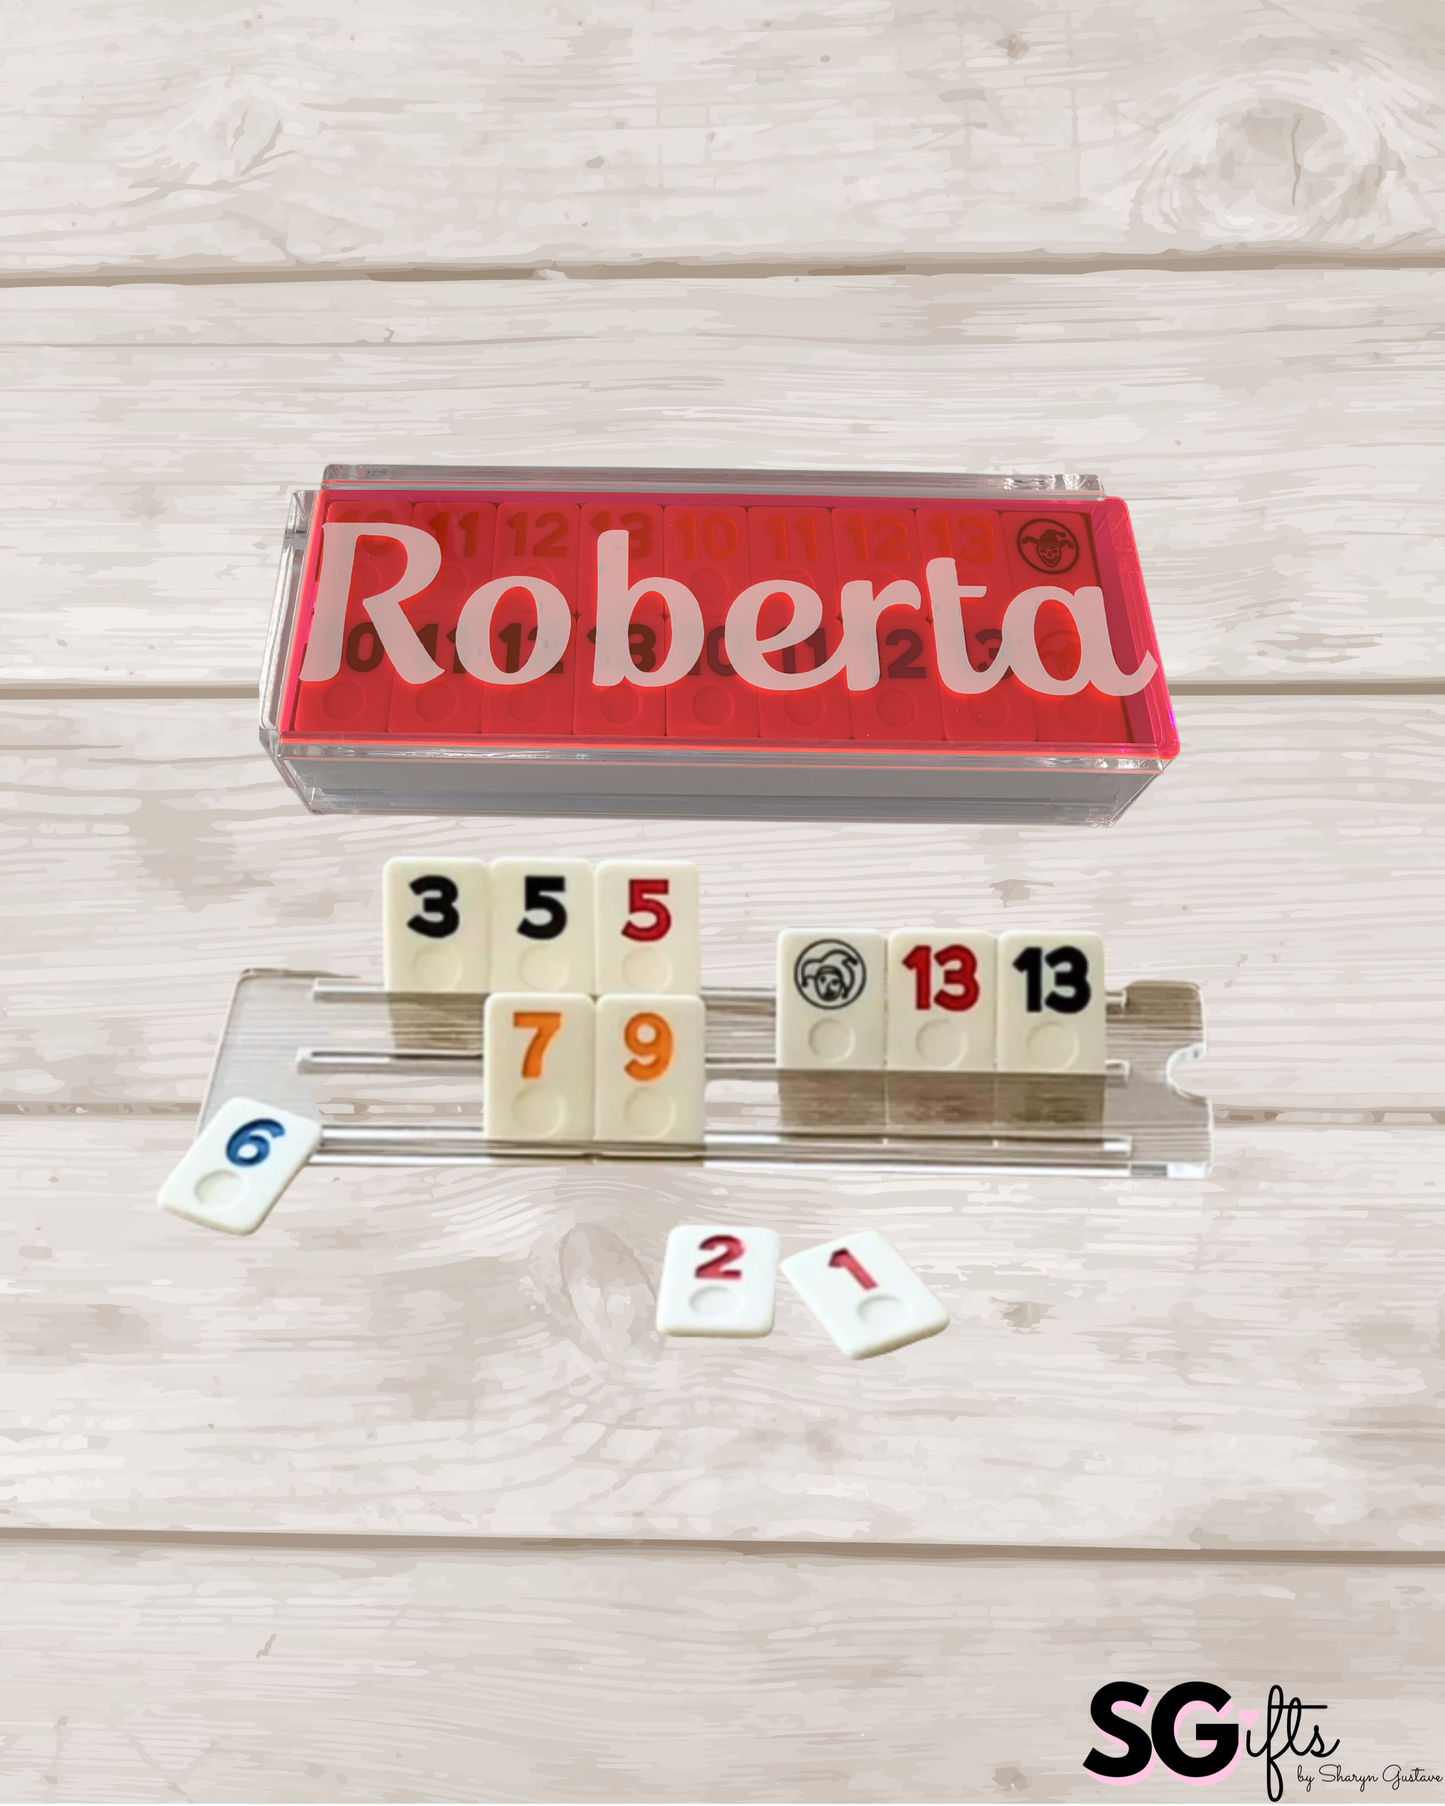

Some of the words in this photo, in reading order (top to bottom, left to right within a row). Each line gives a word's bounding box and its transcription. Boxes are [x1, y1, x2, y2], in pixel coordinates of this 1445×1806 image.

[507, 511, 570, 558] 12
[675, 512, 739, 561] 10
[764, 515, 819, 562] 11
[844, 515, 912, 563] 12
[927, 516, 996, 565] 13
[299, 521, 1158, 696] Roberta
[407, 875, 460, 939] 3
[517, 875, 568, 940] 5
[621, 879, 672, 942] 5
[902, 945, 980, 1012] 13
[1012, 946, 1092, 1014] 13
[512, 1011, 562, 1079] 7
[624, 1012, 674, 1082] 9
[225, 1118, 286, 1168] 6
[694, 1234, 745, 1280] 2
[828, 1247, 879, 1291] 1
